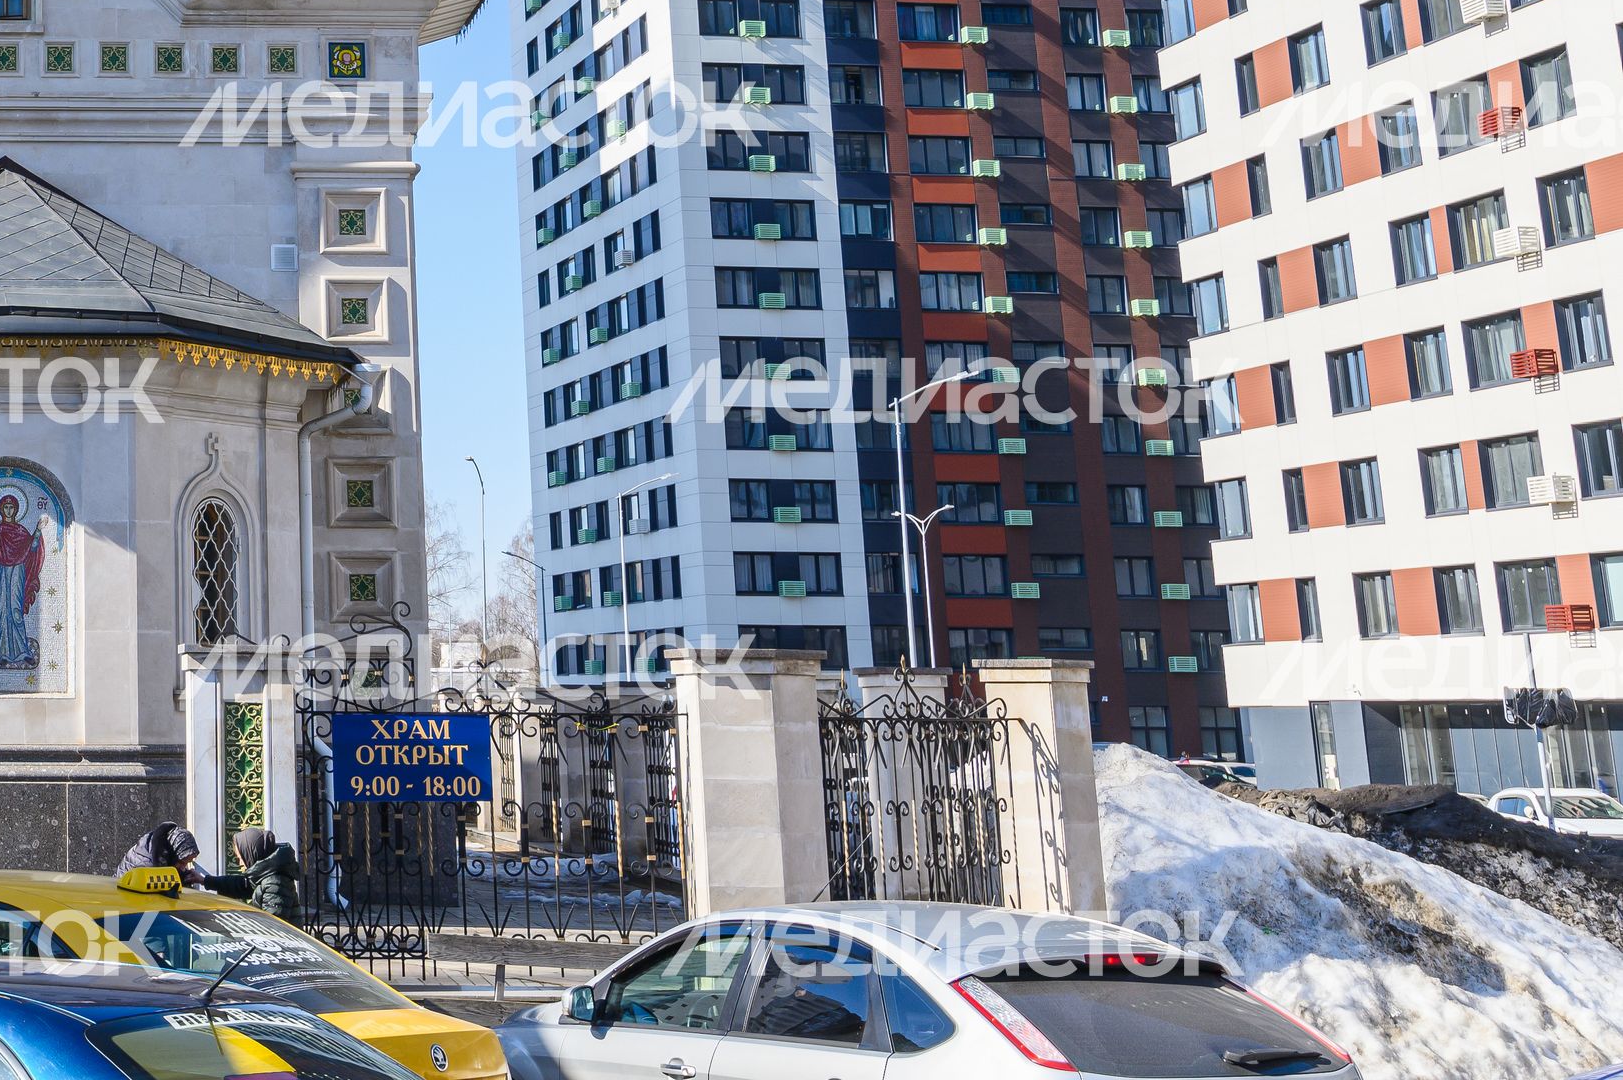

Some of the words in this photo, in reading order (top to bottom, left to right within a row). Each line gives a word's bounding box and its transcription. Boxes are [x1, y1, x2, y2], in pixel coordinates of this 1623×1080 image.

[371, 719, 450, 740] ХРАМ
[355, 744, 469, 765] ОТКРЫТ
[350, 776, 400, 797] 9:00
[424, 776, 481, 797] 18:00
[192, 940, 250, 956] Яндекс
